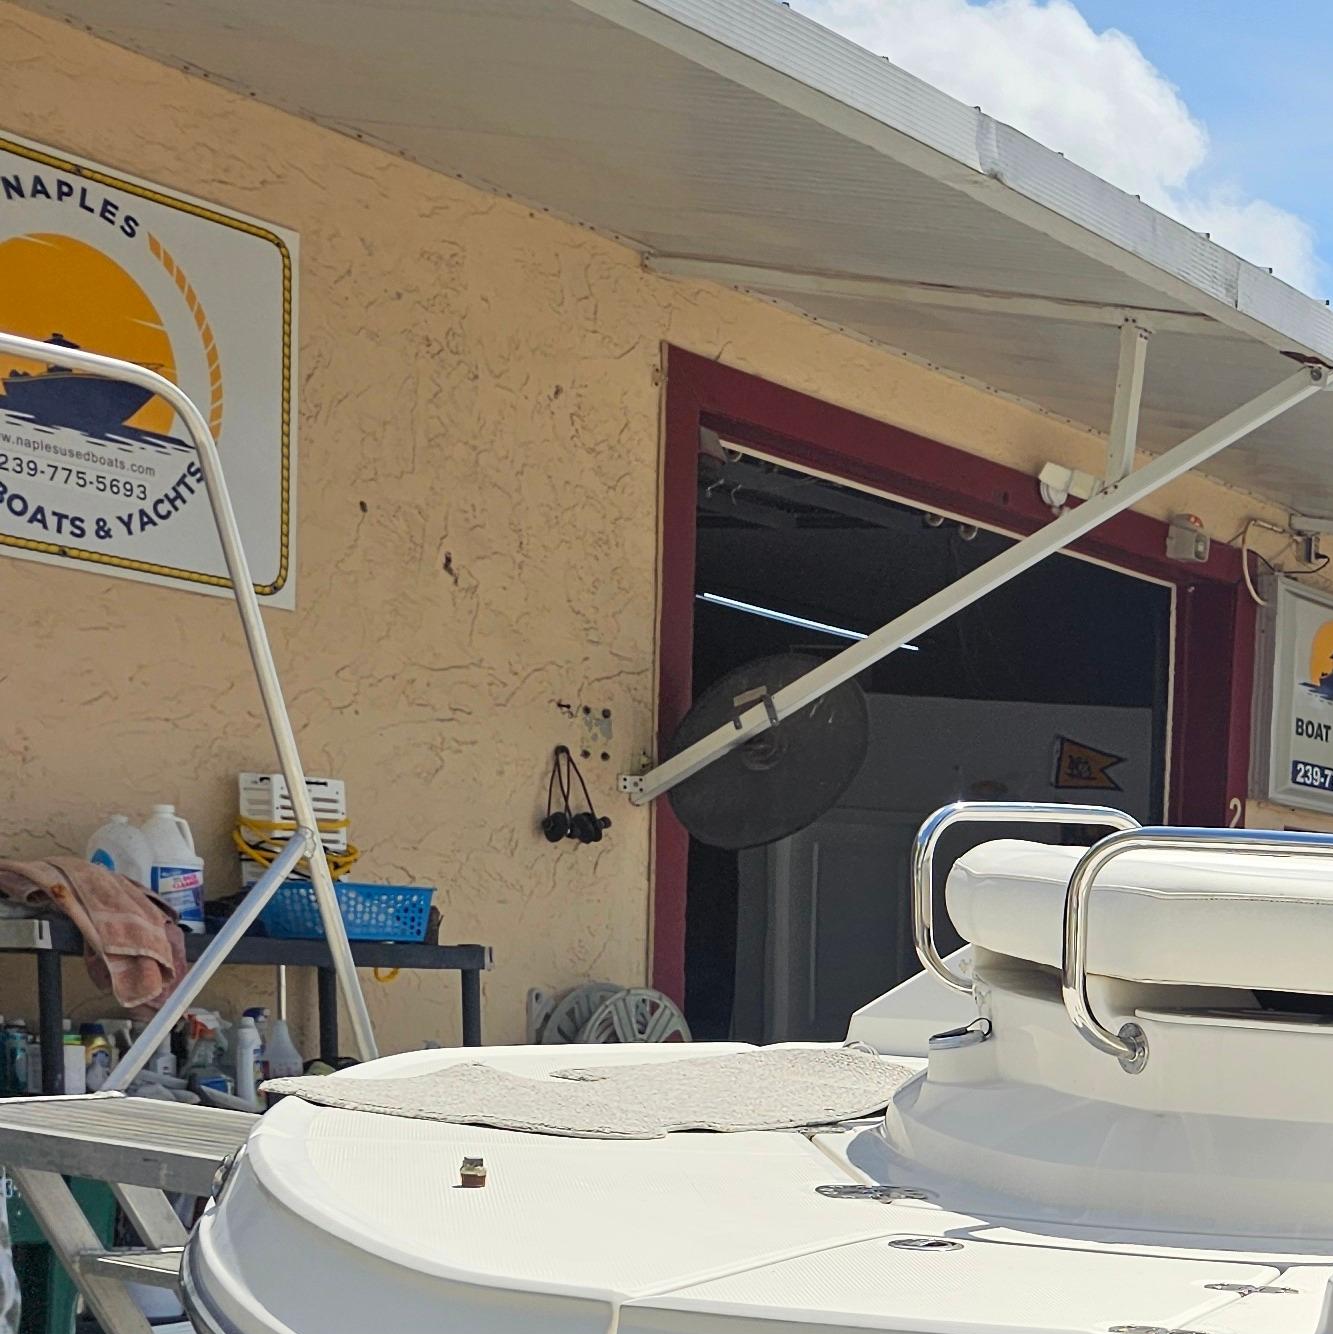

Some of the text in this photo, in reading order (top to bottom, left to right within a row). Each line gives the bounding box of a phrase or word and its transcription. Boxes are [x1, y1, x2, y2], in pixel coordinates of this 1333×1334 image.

[0, 174, 140, 238] NAPLES
[0, 432, 156, 476] w.naplesusedboats.com
[0, 454, 148, 501] 239-775-5693
[95, 517, 113, 540] &
[116, 461, 206, 537] YACHTS
[1295, 717, 1332, 743] BOAT
